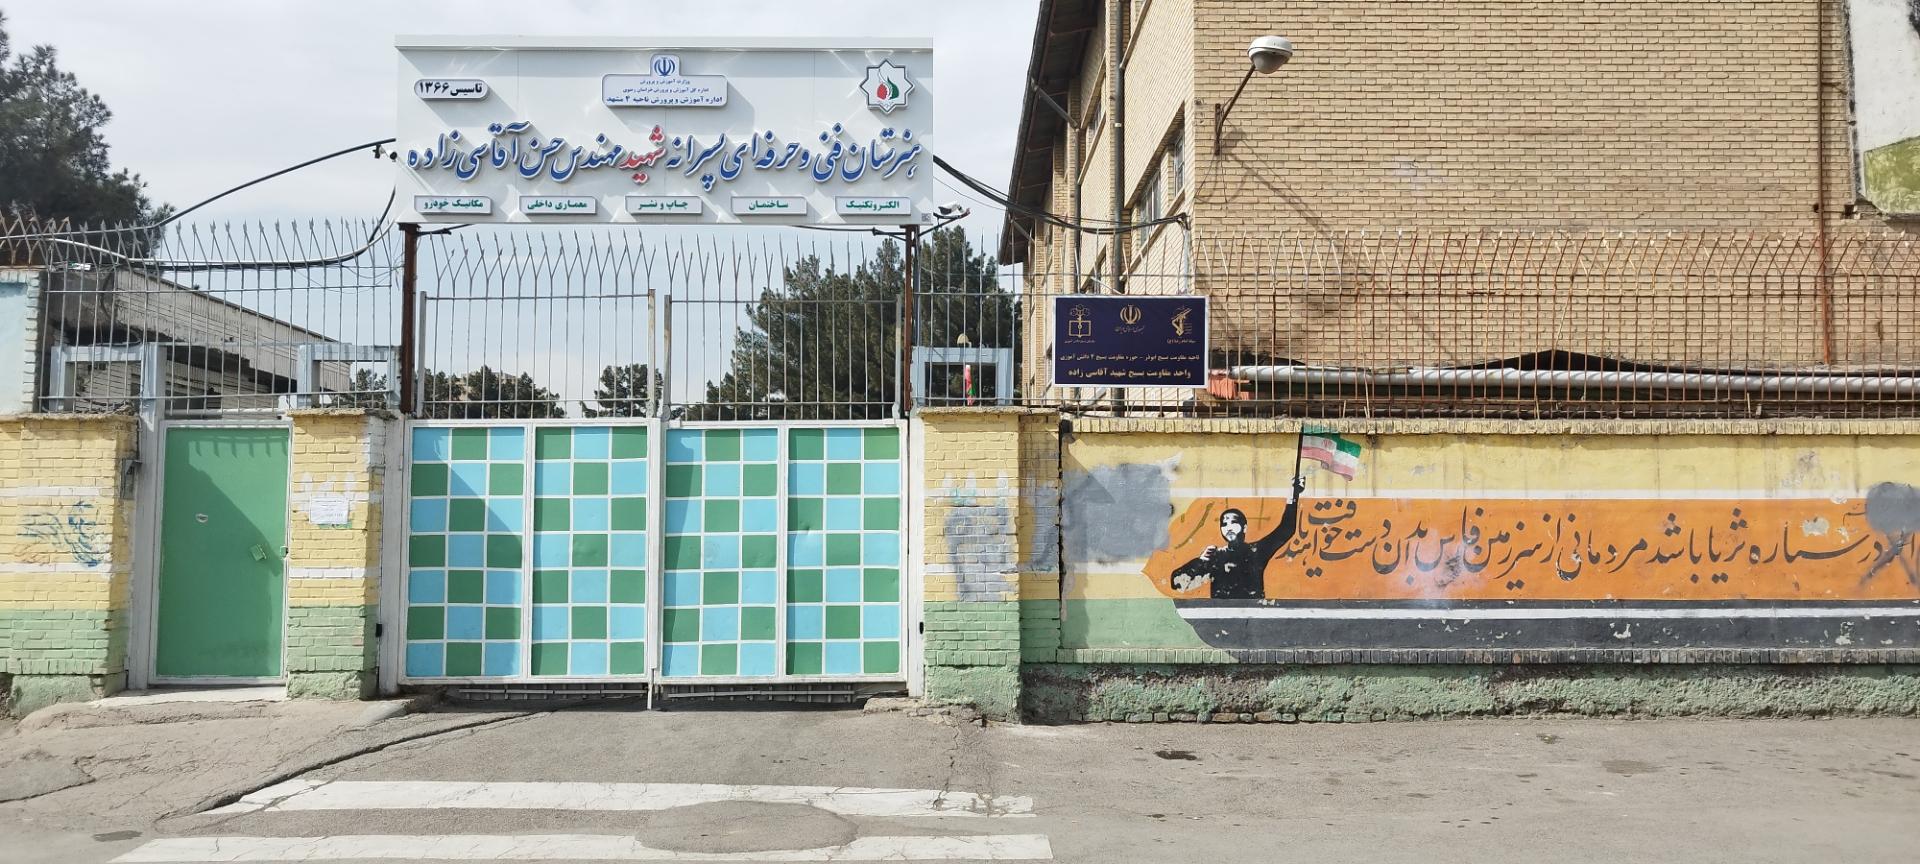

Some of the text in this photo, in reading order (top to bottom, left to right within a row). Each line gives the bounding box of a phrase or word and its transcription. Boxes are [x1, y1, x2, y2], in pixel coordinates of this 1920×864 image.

[419, 81, 450, 94] ۱۳۶۶
[679, 96, 704, 104] آموزش
[705, 96, 723, 104] اداره
[407, 129, 461, 170] زاده
[618, 124, 667, 185] شهید
[811, 122, 843, 183] فنی
[518, 137, 566, 179] حسن
[549, 133, 624, 184] مهندس
[797, 150, 810, 169] و
[840, 128, 922, 183] هنرستان
[665, 132, 726, 192] پسرانه
[423, 200, 484, 210] مکانیک خودرو
[527, 200, 588, 210] معماری داخلی
[638, 200, 658, 210] نشر
[665, 200, 688, 210] چاپ
[748, 200, 788, 210] ساختمان
[1068, 368, 1084, 378] زاده
[1109, 368, 1127, 378] شهید
[1147, 369, 1171, 378] مقاومت
[1173, 369, 1191, 378] واحد
[1645, 512, 1703, 583] باشد
[1708, 507, 1748, 583] ثریا
